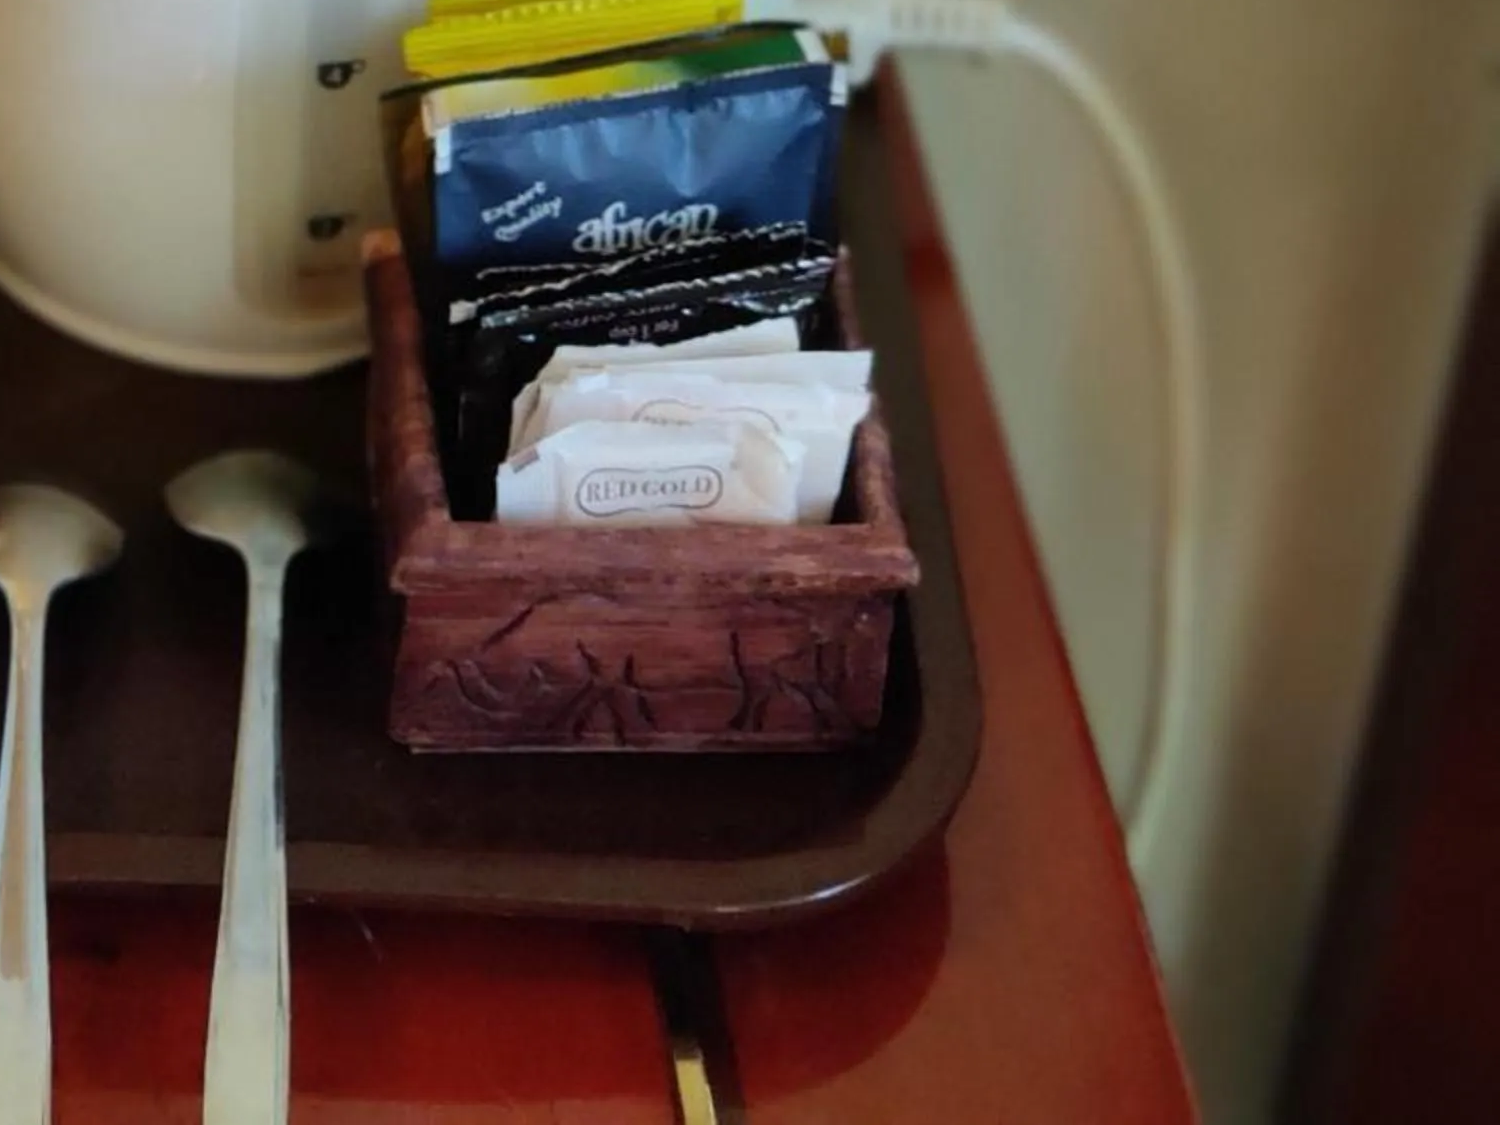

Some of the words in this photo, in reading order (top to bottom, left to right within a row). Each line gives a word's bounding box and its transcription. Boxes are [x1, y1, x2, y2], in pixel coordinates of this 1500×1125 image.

[480, 181, 546, 225] Export
[572, 201, 719, 255] african
[585, 478, 638, 503] RED
[640, 475, 714, 496] GOLD
